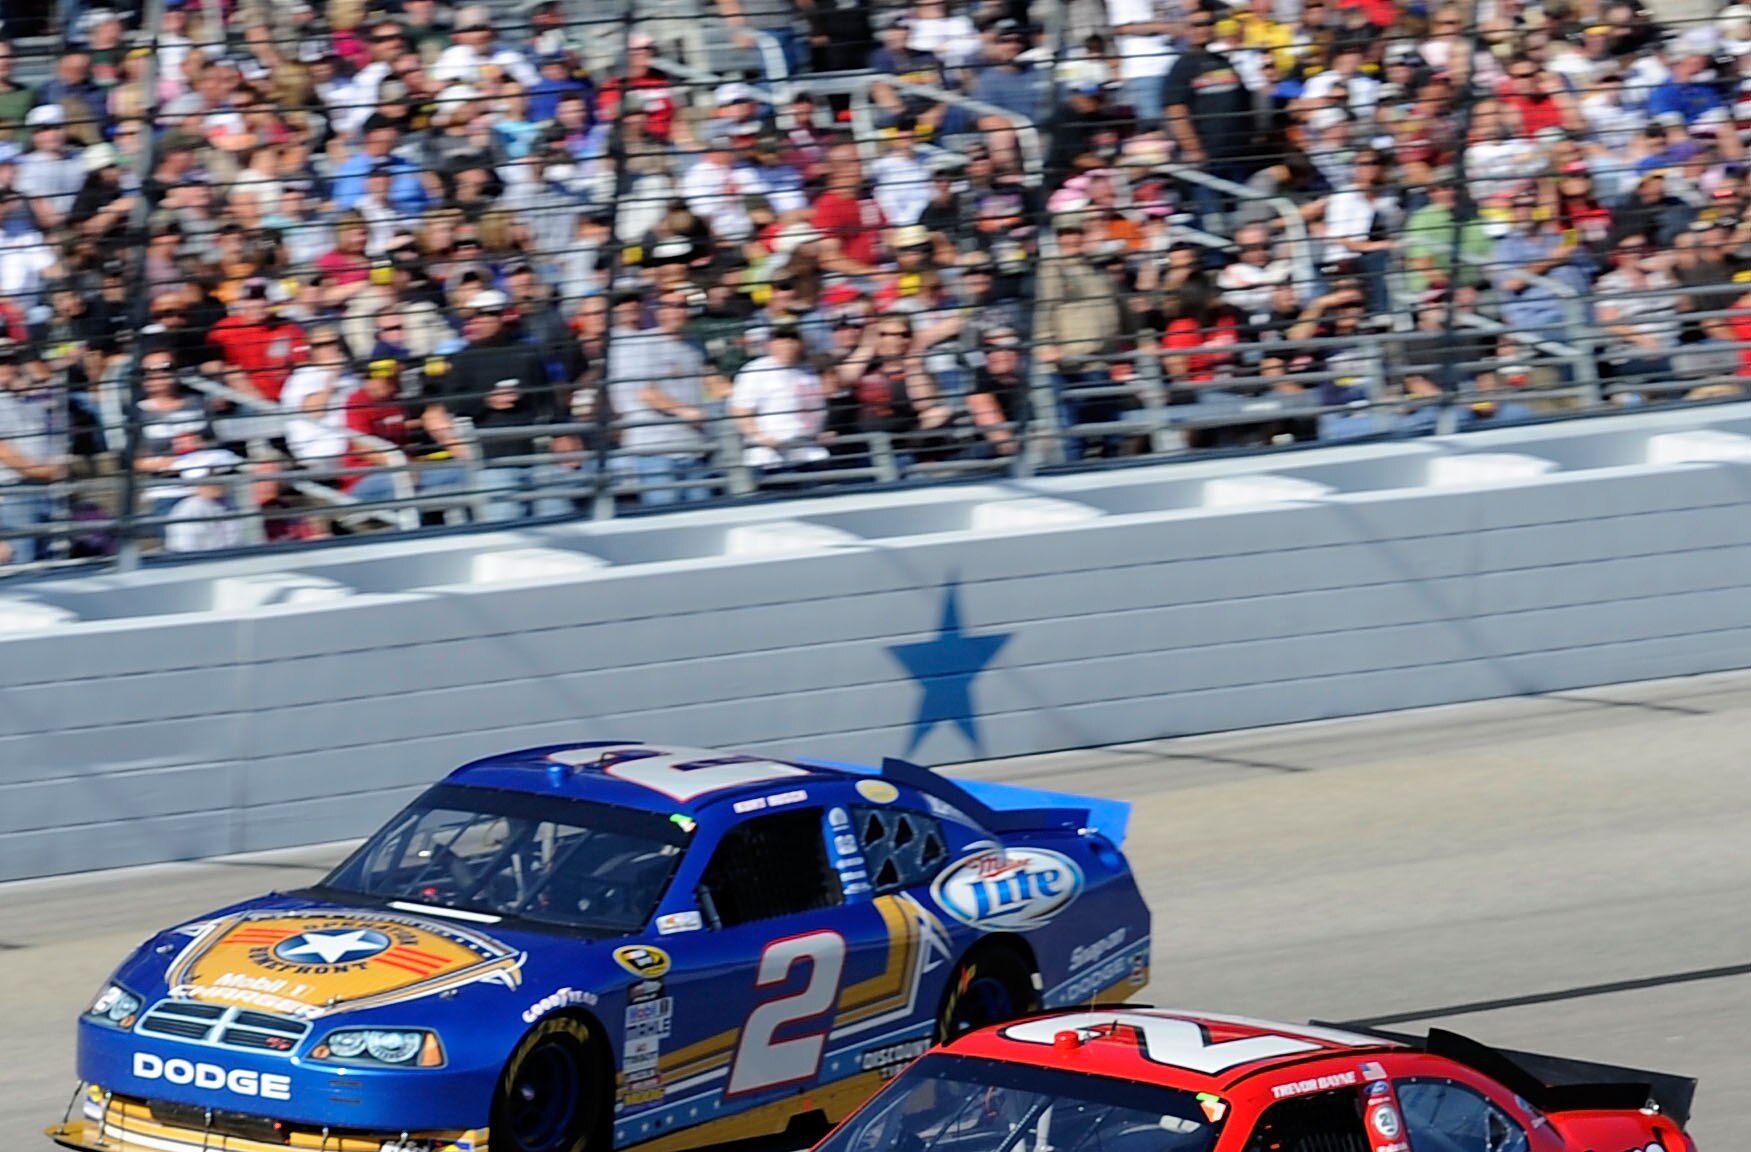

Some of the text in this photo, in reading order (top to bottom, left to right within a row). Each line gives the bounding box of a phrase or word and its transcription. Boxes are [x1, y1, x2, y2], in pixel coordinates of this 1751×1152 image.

[970, 869, 1062, 918] Lite
[214, 972, 287, 993] Mobil
[726, 930, 846, 1098] 2
[133, 1052, 291, 1101] DODGE
